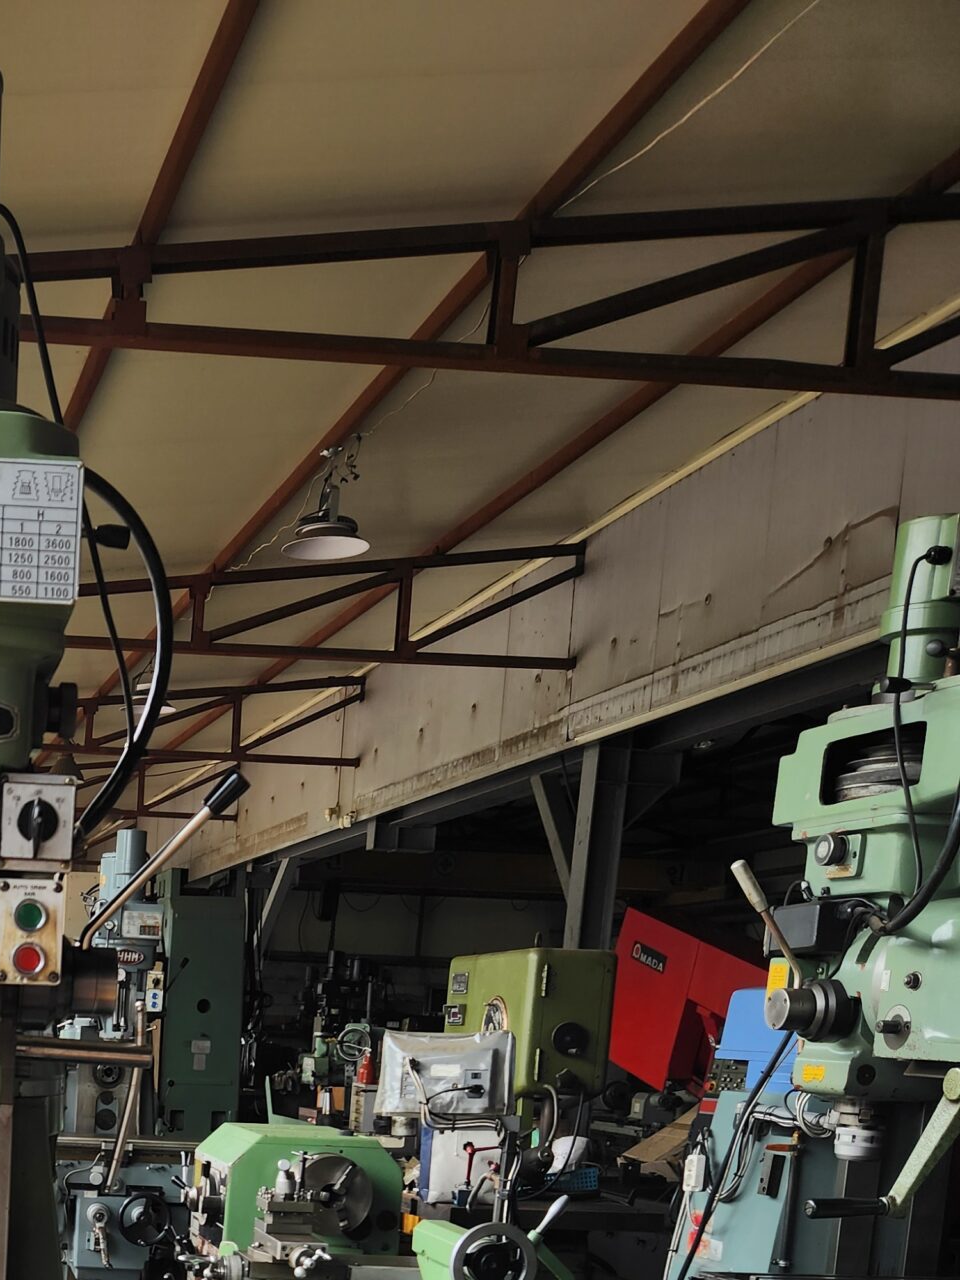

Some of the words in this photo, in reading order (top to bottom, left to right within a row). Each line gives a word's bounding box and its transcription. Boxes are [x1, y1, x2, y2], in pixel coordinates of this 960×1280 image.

[37, 510, 45, 520] H
[55, 524, 62, 534] 2
[9, 536, 34, 548] 1800
[45, 538, 71, 550] 3600
[8, 553, 33, 564] 1250
[43, 555, 71, 566] 2500
[11, 569, 32, 580] 800
[44, 571, 70, 582] 1600
[11, 585, 32, 596] 550
[43, 587, 69, 598] 1100
